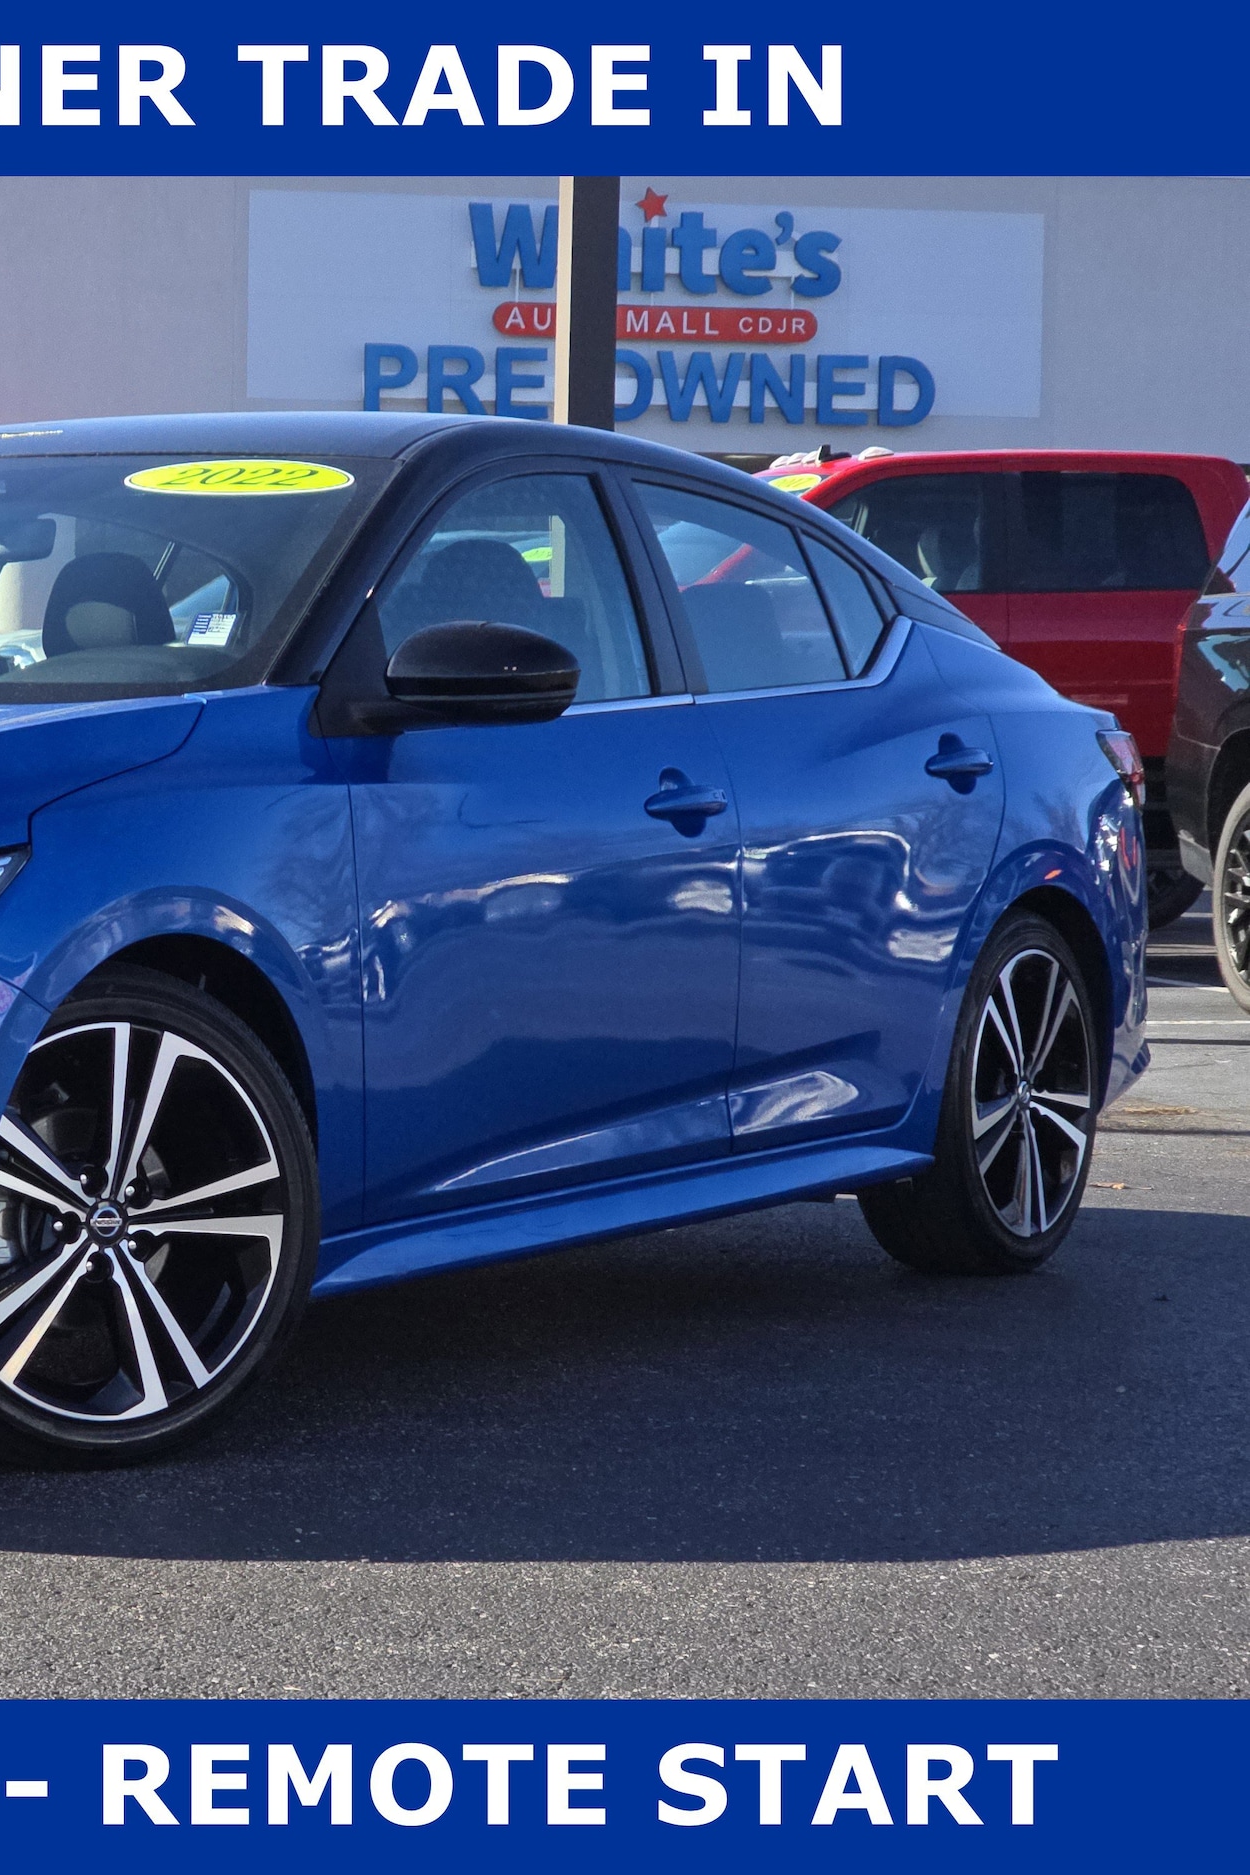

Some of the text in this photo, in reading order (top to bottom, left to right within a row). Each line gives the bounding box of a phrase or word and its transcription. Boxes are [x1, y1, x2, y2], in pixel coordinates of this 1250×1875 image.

[505, 306, 806, 336] AU MALL CDJR
[364, 343, 549, 420] PRE
[158, 467, 319, 487] 2022
